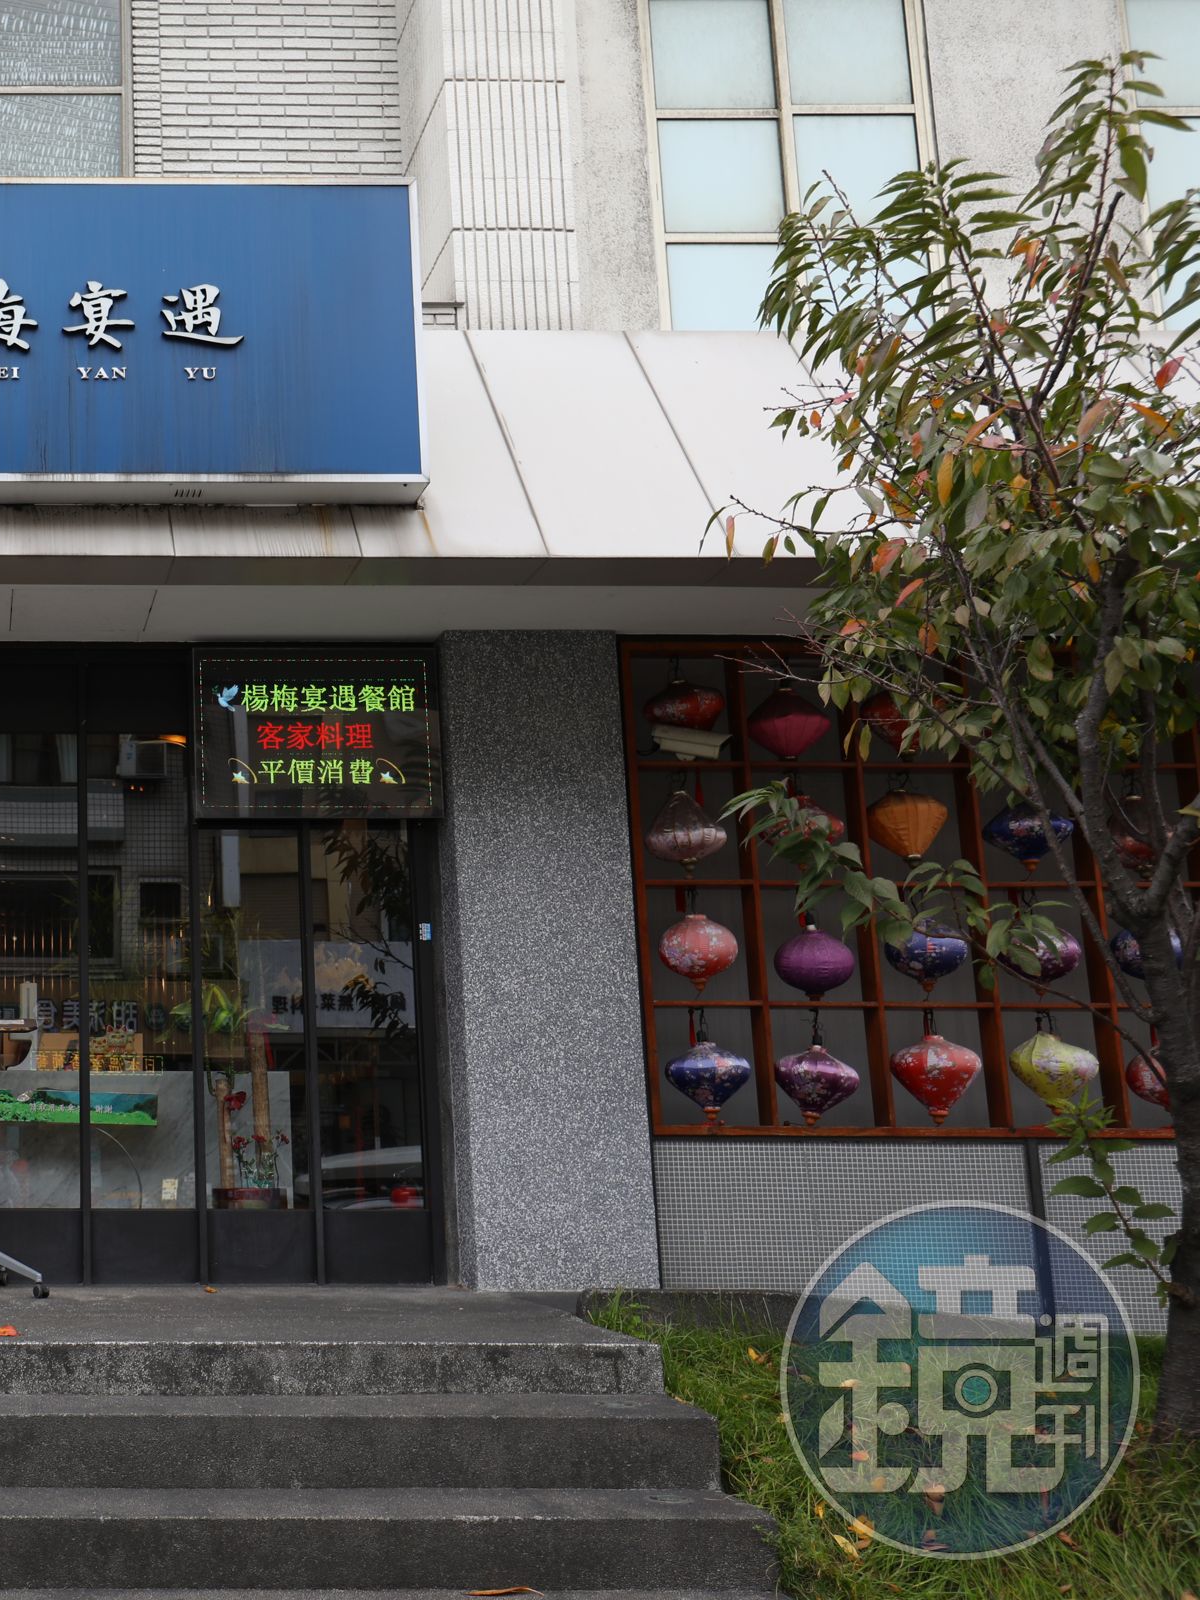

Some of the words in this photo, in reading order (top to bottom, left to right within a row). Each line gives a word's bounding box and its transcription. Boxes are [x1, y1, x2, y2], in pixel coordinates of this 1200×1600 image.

[76, 365, 128, 380] YAN
[183, 365, 218, 380] YU
[240, 684, 416, 713] 楊梅宴遇餐館
[257, 721, 375, 750] 客家料理
[258, 758, 375, 785] 平價消費
